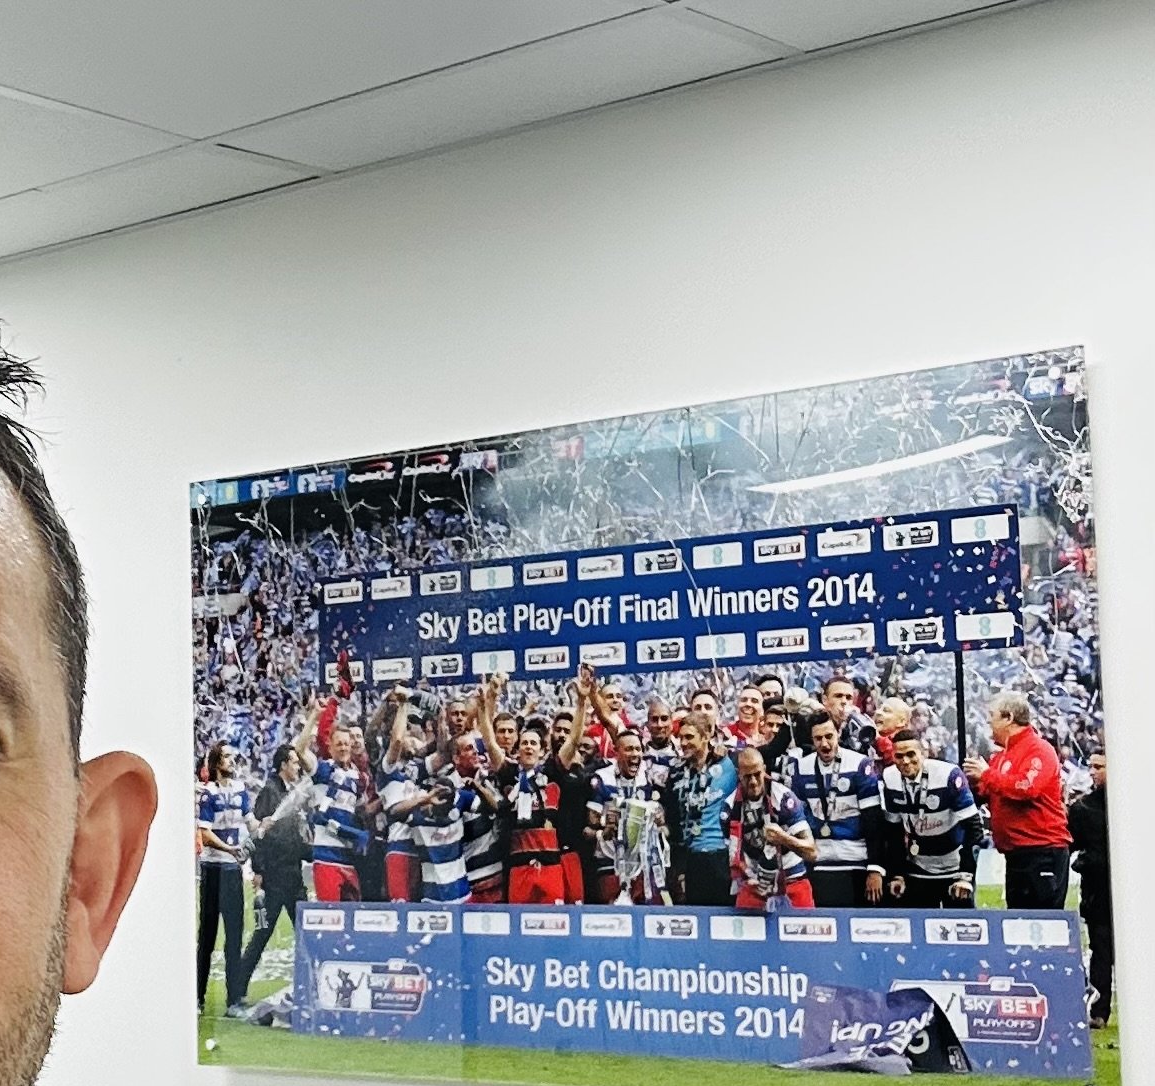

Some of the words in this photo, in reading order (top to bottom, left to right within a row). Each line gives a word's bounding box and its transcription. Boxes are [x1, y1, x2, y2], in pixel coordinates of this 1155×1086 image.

[419, 611, 461, 644] Sky
[468, 606, 507, 635] Bet
[513, 596, 612, 635] Play-Off
[620, 591, 679, 624] Final
[687, 586, 799, 617] Winners
[807, 572, 876, 608] 2014
[486, 956, 536, 992] Sky
[545, 958, 590, 989] Bet
[598, 959, 808, 1004] Championship
[490, 994, 598, 1032] Play-Off
[605, 1000, 725, 1035] Winners
[735, 1006, 805, 1039] 2014
[1001, 998, 1040, 1014] BET
